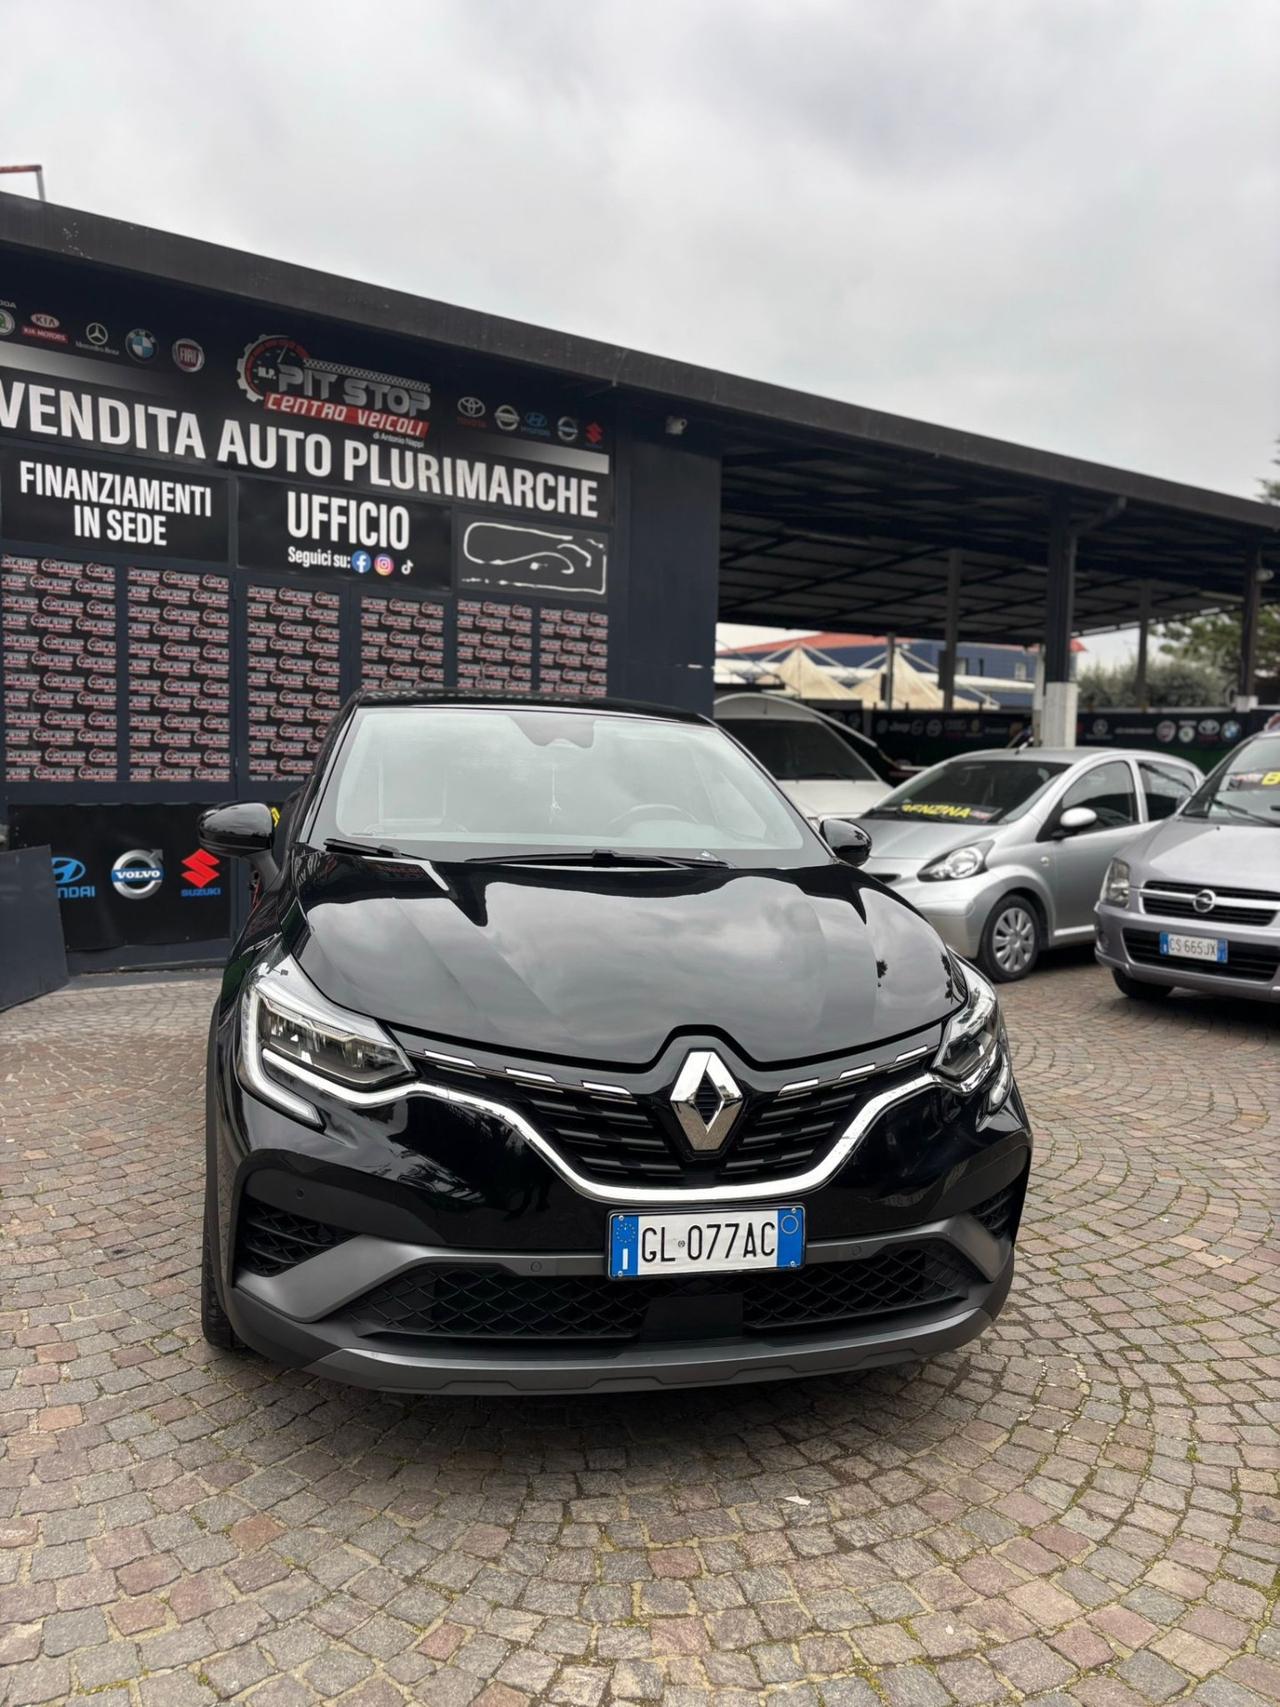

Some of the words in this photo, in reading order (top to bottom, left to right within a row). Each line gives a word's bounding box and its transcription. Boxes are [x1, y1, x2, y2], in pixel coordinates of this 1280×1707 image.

[35, 315, 57, 327] KIA
[277, 364, 338, 400] PIT
[343, 378, 431, 417] STOP
[0, 380, 206, 460] VENDITA
[217, 418, 332, 477] AUTO
[344, 439, 598, 518] PLURIMARCHE
[20, 460, 212, 517] FINANZIAMENTI
[74, 505, 100, 539] IN
[106, 509, 167, 546] SEDE
[287, 491, 410, 550] UFFICIO
[288, 545, 332, 568] Seguici
[333, 554, 351, 569] su:
[56, 886, 95, 898] NDAI
[115, 869, 161, 879] VOLVO
[180, 887, 221, 897] SUZUKI
[641, 1226, 676, 1263] GL
[687, 1221, 776, 1261] 077AC
